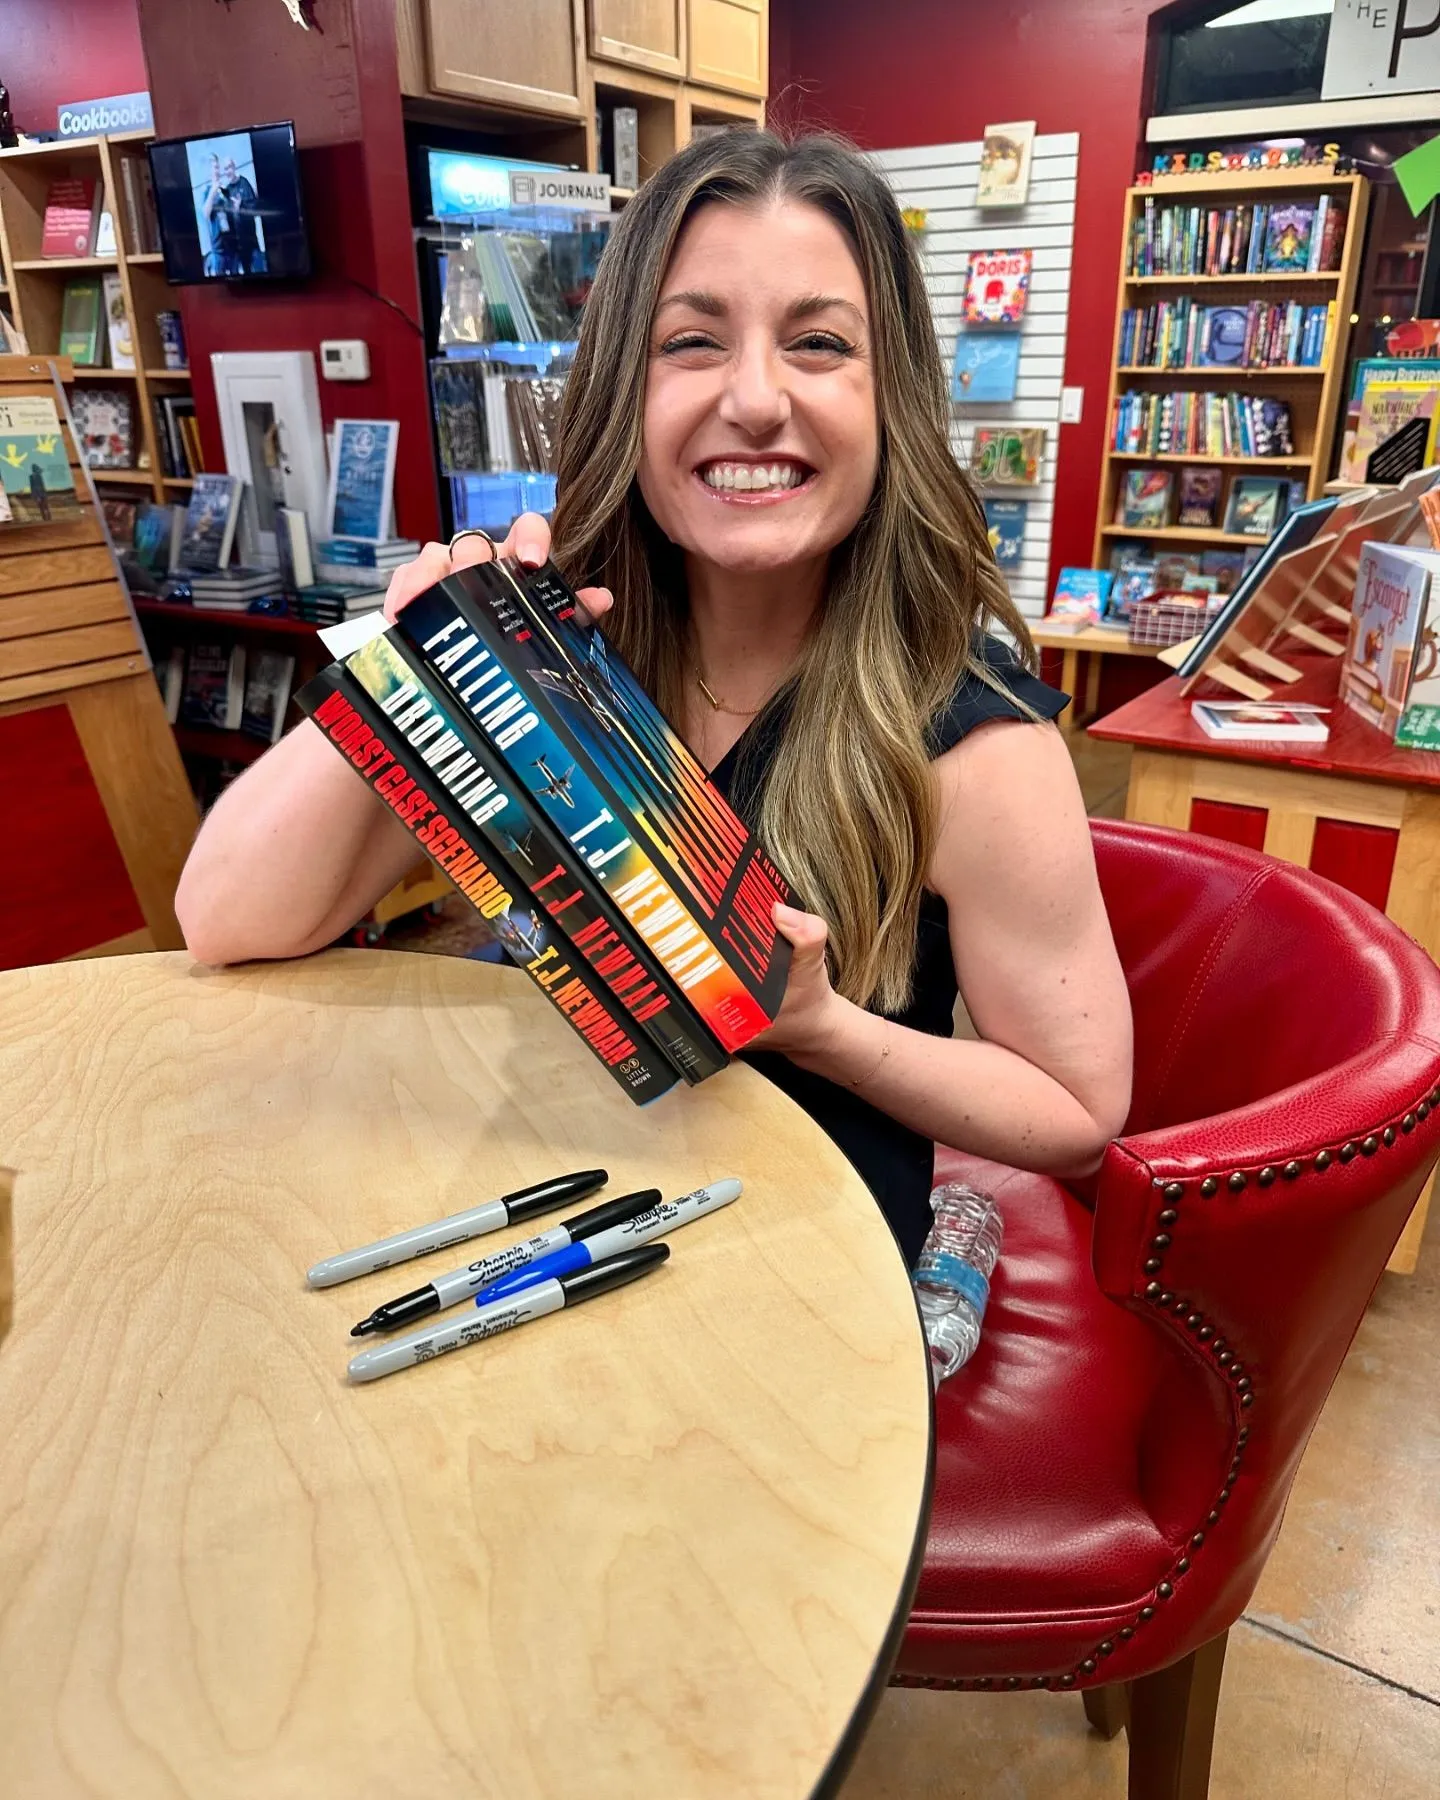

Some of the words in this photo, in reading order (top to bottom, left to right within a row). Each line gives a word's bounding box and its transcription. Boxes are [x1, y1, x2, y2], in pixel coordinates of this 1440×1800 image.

[59, 103, 149, 136] Cookbooks
[539, 183, 606, 201] JOURNALS
[977, 259, 1021, 278] DORIS
[422, 616, 540, 751] FALLING
[380, 681, 509, 827] DROWNING
[313, 689, 396, 778] WORST
[373, 764, 438, 830] CASE
[415, 814, 514, 920] SCENARIO
[754, 847, 762, 859] A
[762, 857, 790, 900] NOVEL
[569, 807, 632, 880] T.J.
[612, 867, 723, 991] NEWMAN
[529, 863, 585, 926] T.J.
[570, 916, 671, 1023] NEWMAN
[526, 945, 572, 992] T.J.
[551, 976, 639, 1067] NEWMAN
[631, 1073, 652, 1088] BROWN
[634, 1219, 661, 1235] Permanent
[662, 1210, 679, 1222] Marker
[468, 1246, 528, 1286] Sharpie
[460, 1322, 481, 1333] Marker
[486, 1308, 518, 1326] Permanent
